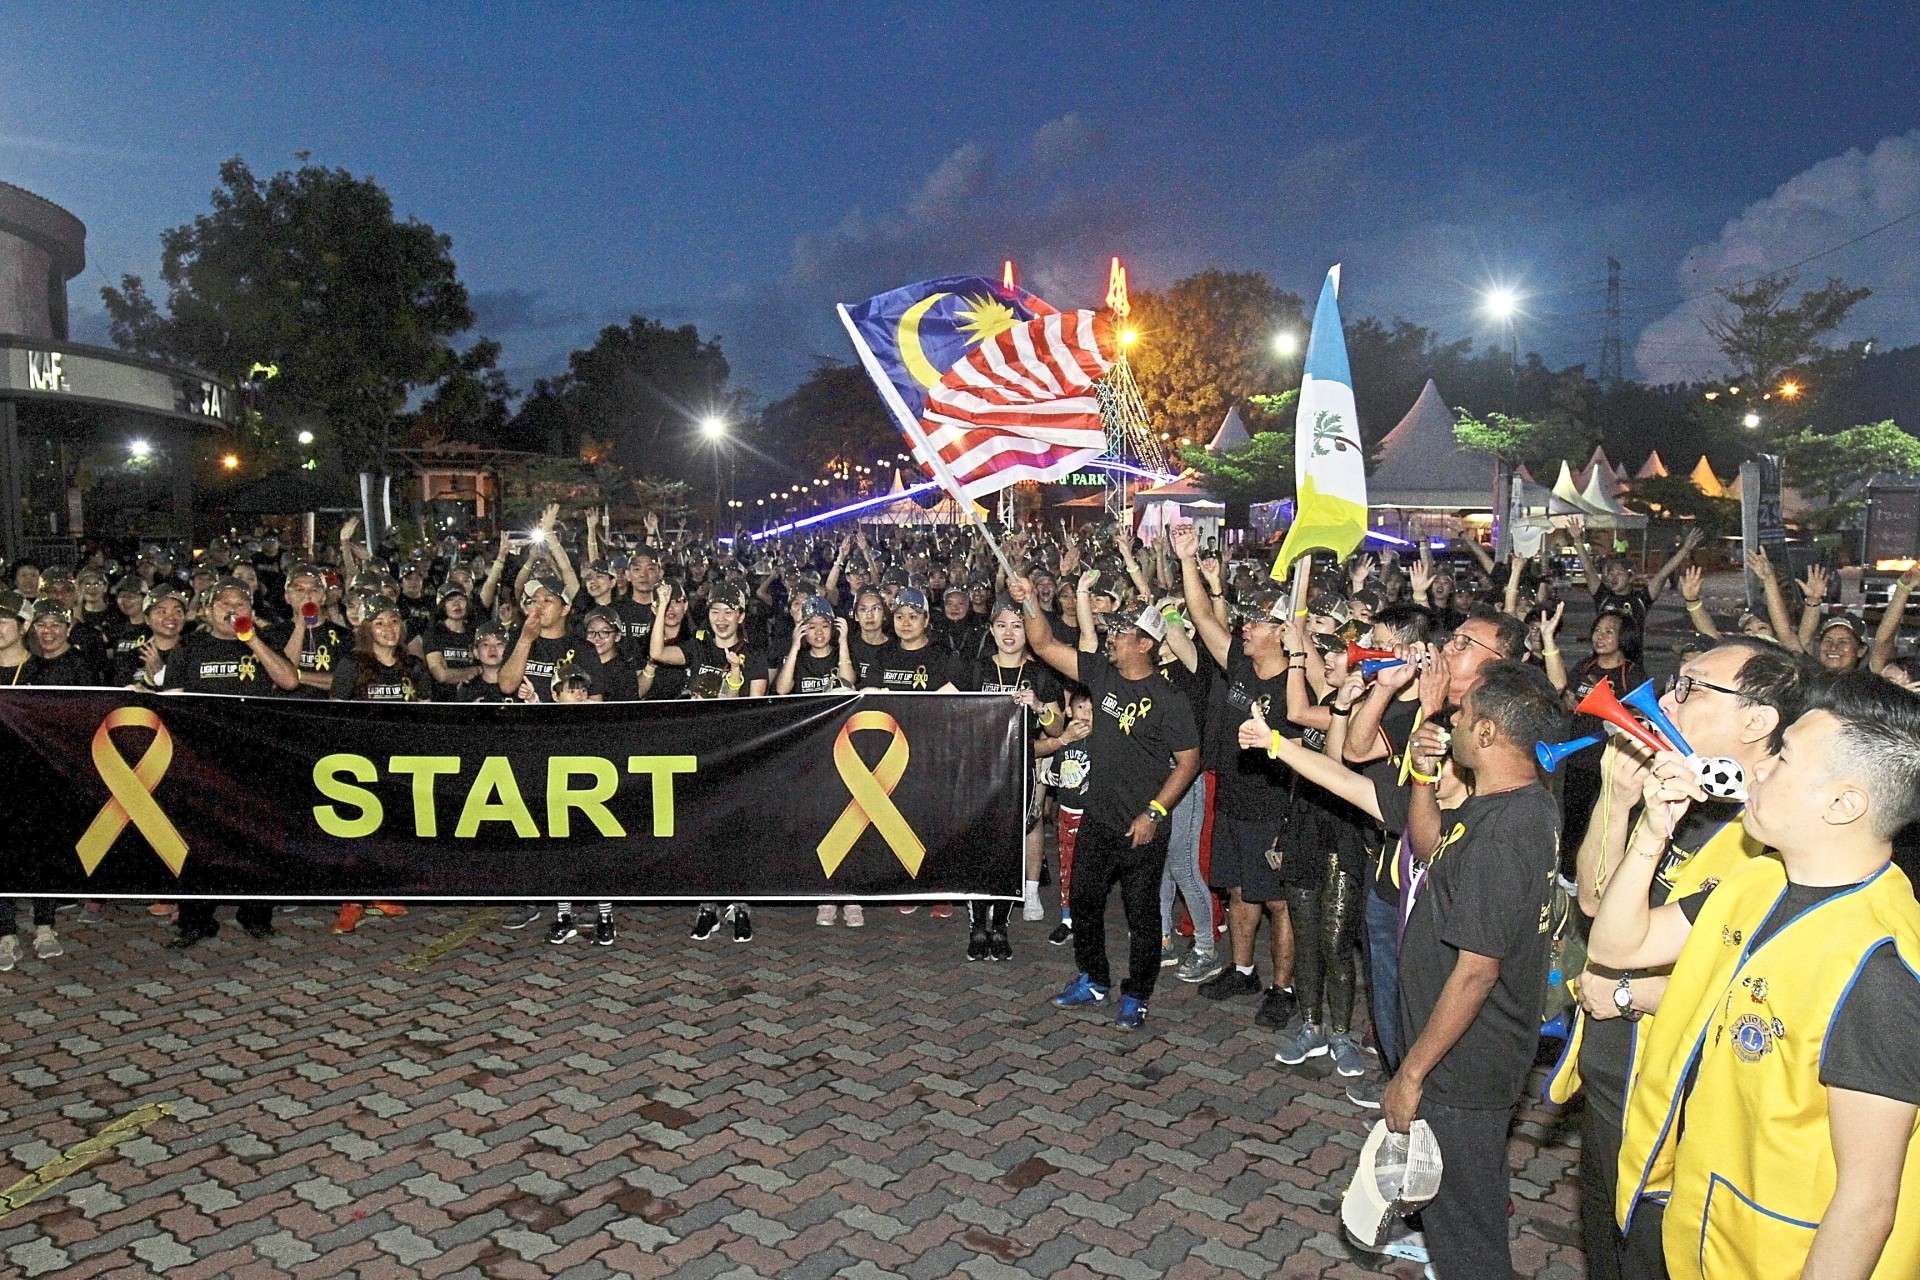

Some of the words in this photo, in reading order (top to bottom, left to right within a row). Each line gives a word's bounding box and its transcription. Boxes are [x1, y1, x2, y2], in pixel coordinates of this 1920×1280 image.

[1072, 473, 1107, 485] PARK
[200, 665, 220, 674] LIGHT
[219, 665, 227, 673] IT
[227, 665, 238, 673] UP
[543, 665, 553, 673] UP
[883, 671, 899, 681] LIGHT
[903, 673, 913, 681] UP
[801, 680, 817, 689] LIGHT
[312, 753, 699, 839] START
